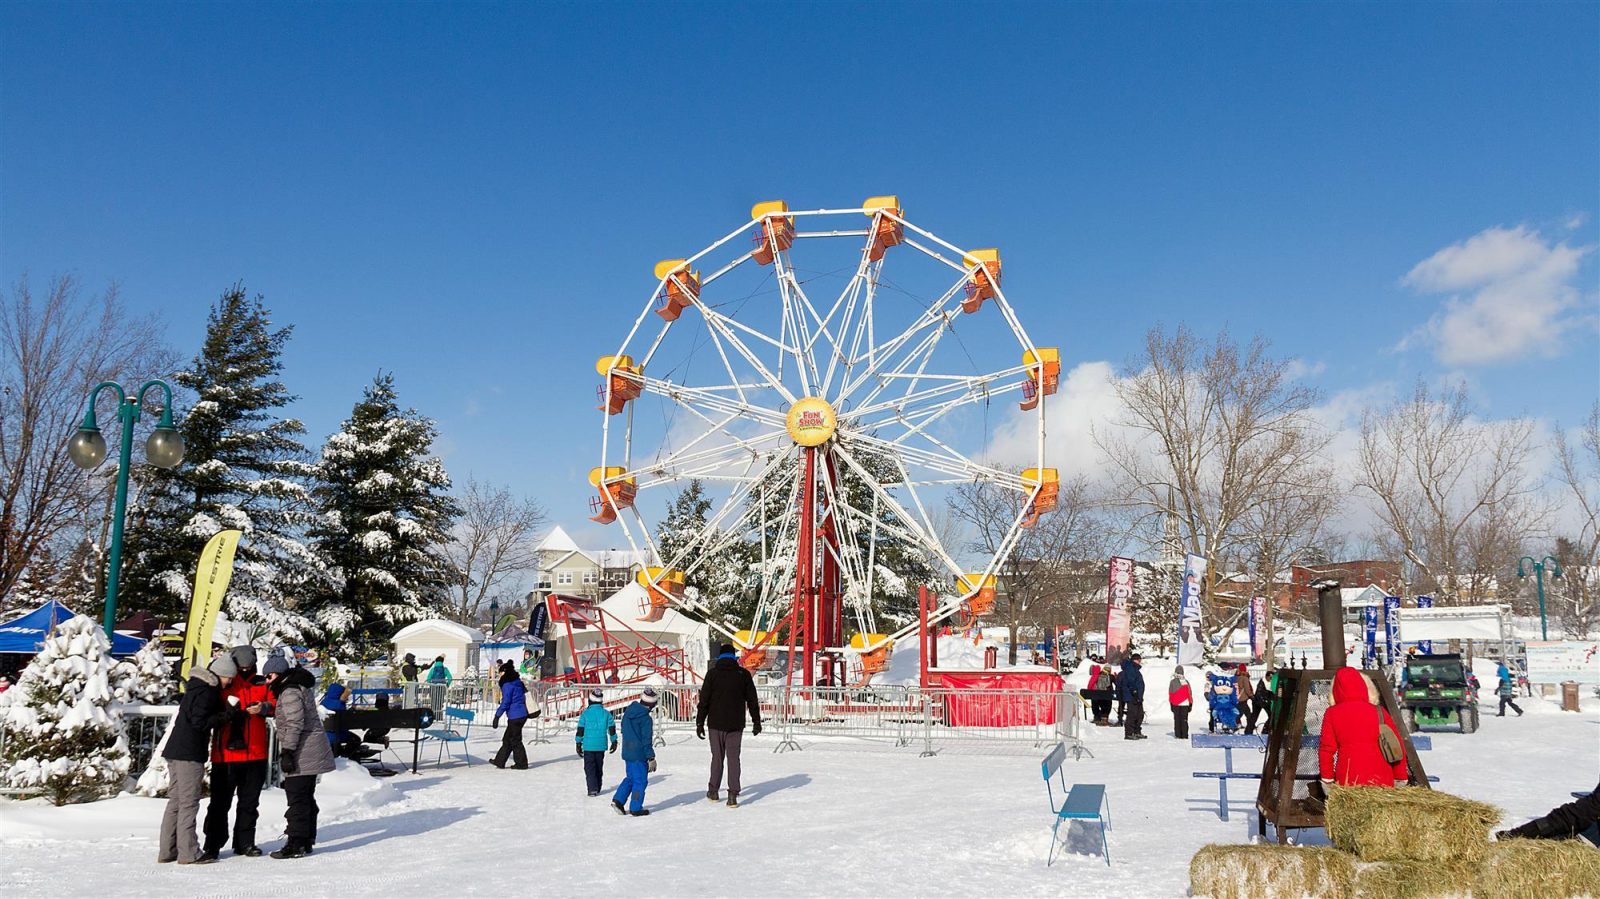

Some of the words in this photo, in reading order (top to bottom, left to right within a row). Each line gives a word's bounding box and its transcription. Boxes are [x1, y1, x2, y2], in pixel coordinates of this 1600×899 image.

[196, 590, 211, 645] SPORTS
[209, 537, 226, 584] ESTRIE
[1109, 560, 1132, 628] Magog
